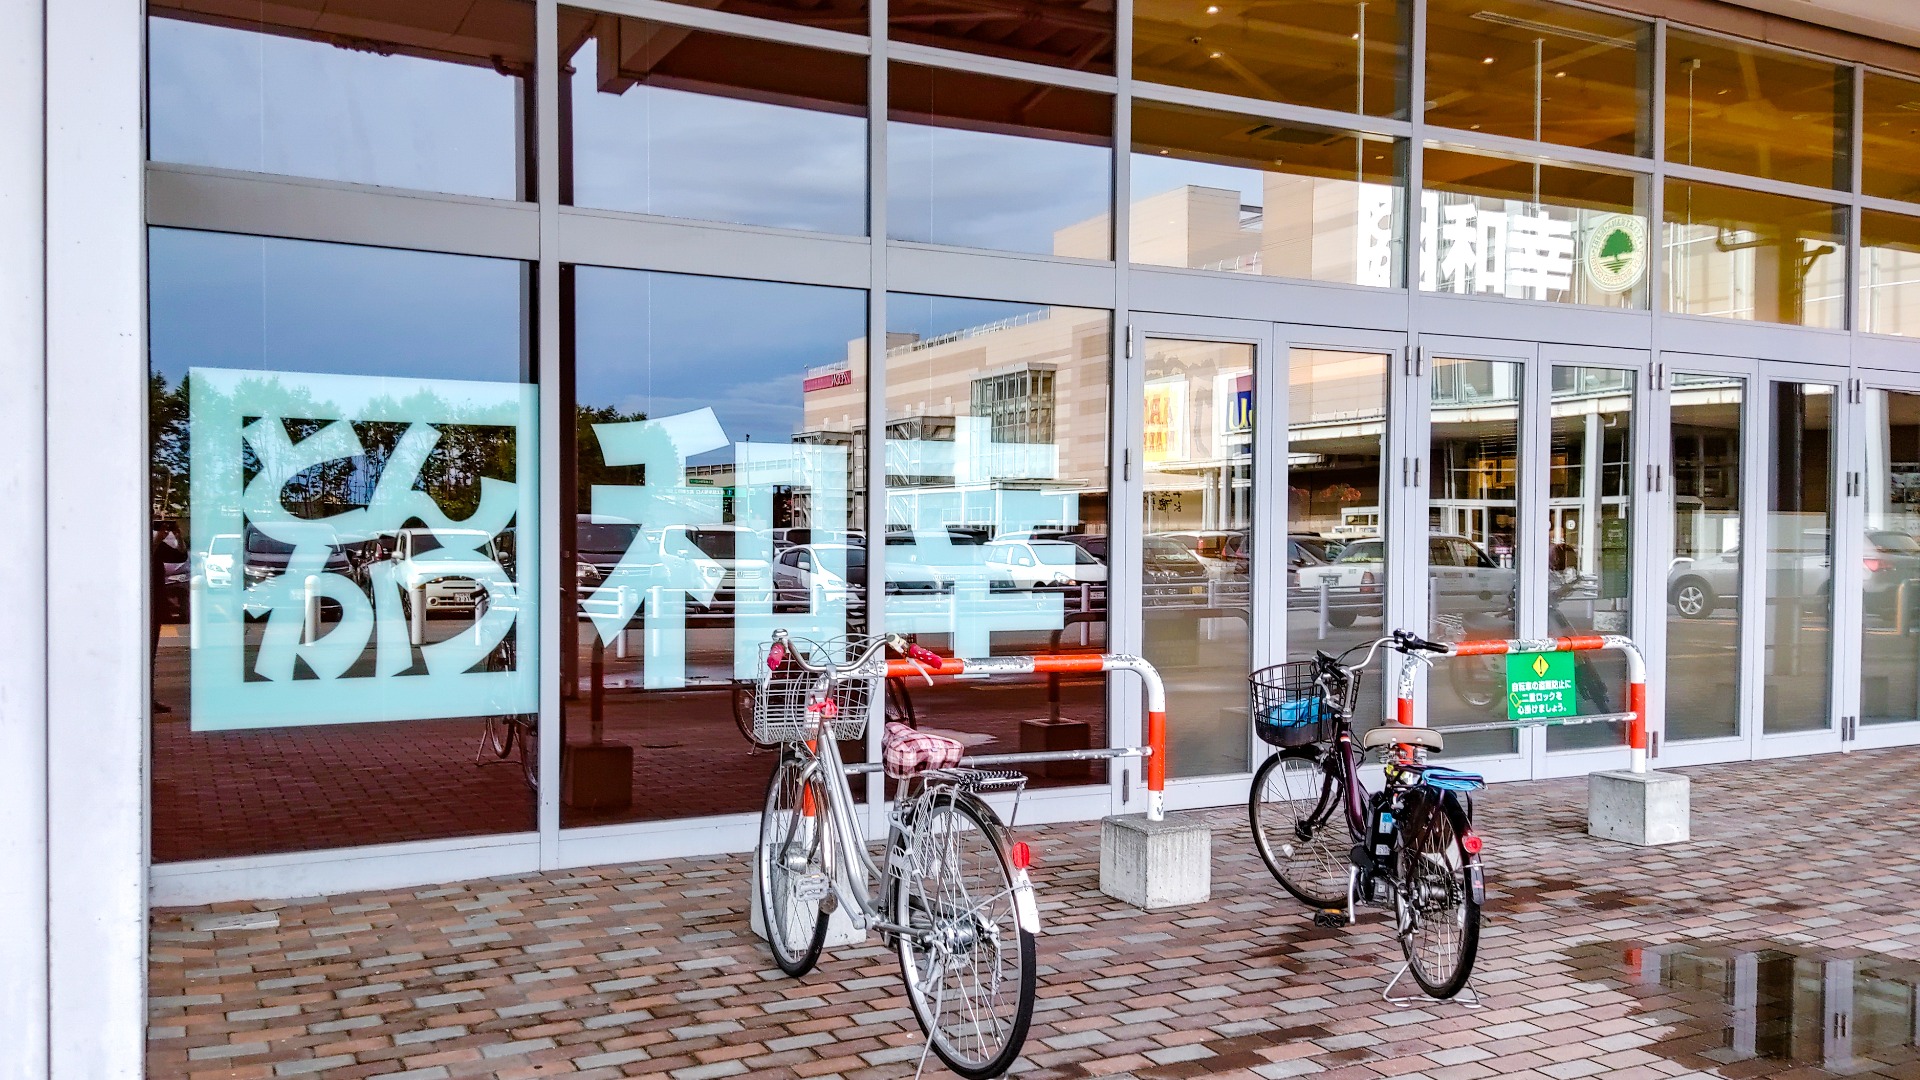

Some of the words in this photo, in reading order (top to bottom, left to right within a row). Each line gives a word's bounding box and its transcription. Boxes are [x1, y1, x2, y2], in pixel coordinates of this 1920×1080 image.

[1511, 679, 1572, 692] 自転車の盗難防止に
[1521, 691, 1563, 702] 二重ロックを
